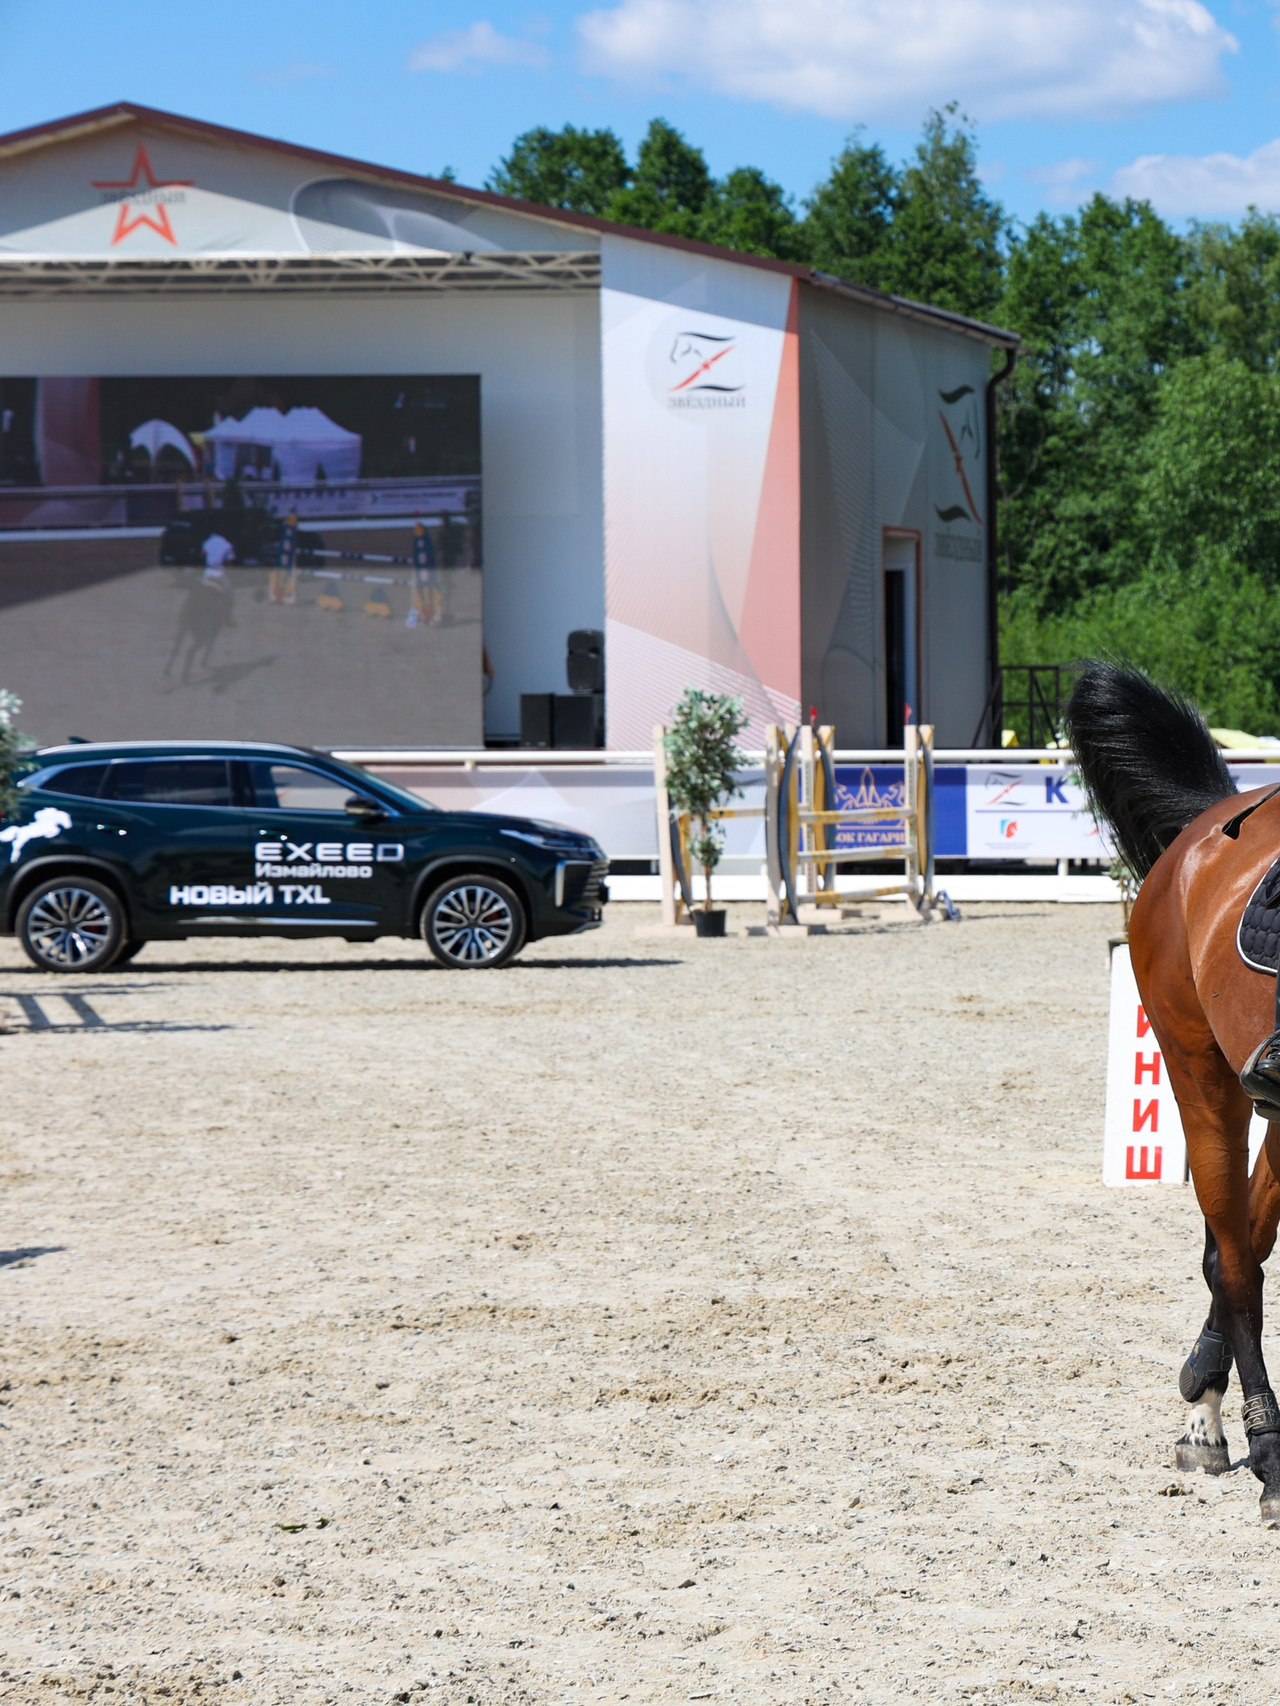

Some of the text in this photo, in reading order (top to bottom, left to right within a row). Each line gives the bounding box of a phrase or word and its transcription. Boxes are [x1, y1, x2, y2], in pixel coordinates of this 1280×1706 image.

[255, 842, 404, 862] EXEED
[255, 862, 373, 879] Измайлово
[169, 881, 332, 905] НОВЫЙ TXL
